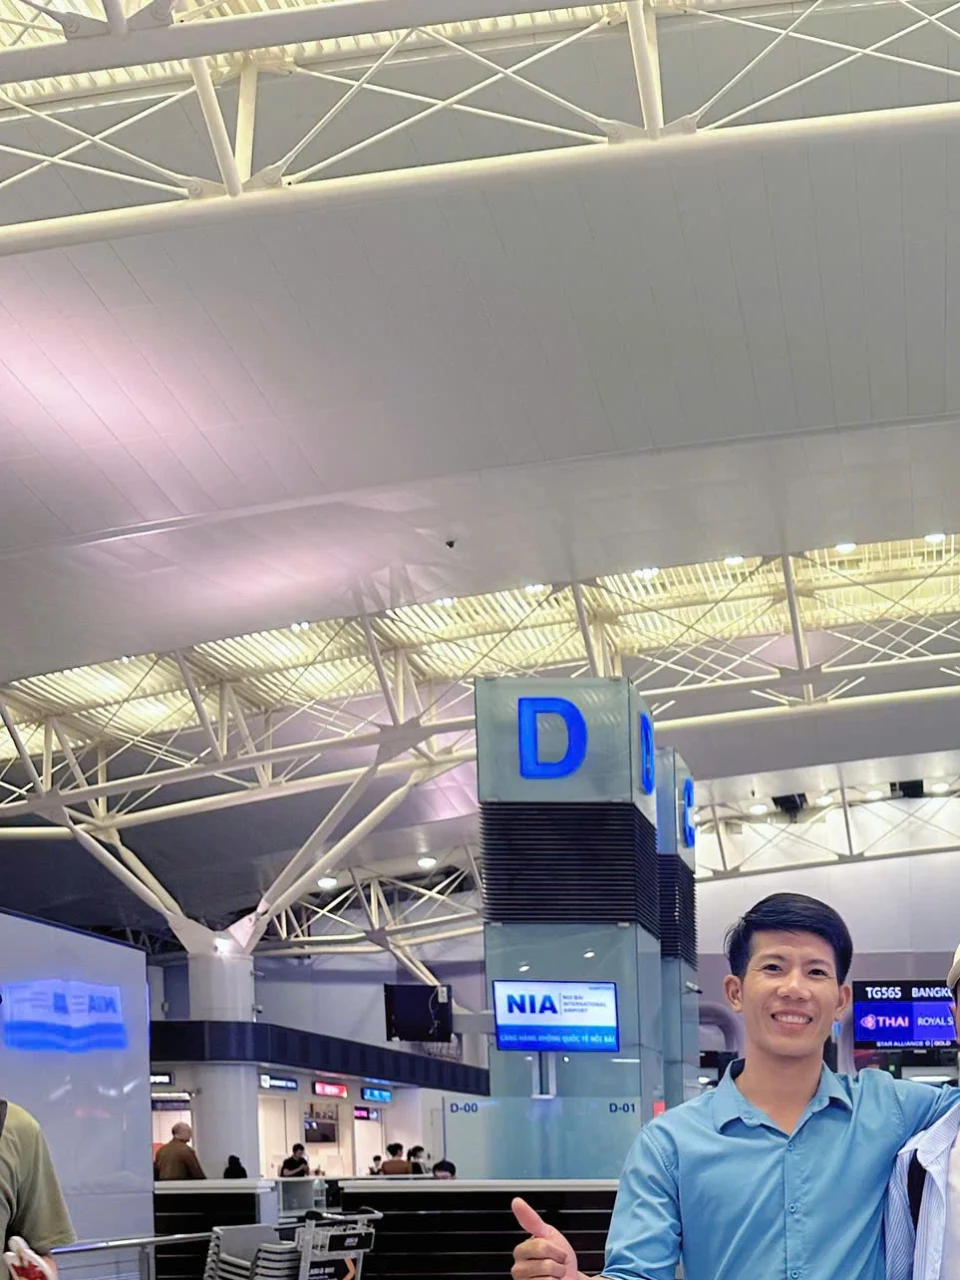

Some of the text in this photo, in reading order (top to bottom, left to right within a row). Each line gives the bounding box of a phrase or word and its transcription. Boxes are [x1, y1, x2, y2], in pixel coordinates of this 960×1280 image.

[518, 697, 588, 779] D
[865, 986, 902, 999] TG565
[507, 994, 558, 1014] NIA
[877, 1016, 909, 1027] THAI
[917, 1017, 946, 1026] ROYAL
[450, 1103, 478, 1113] D-00
[609, 1103, 636, 1113] D-01
